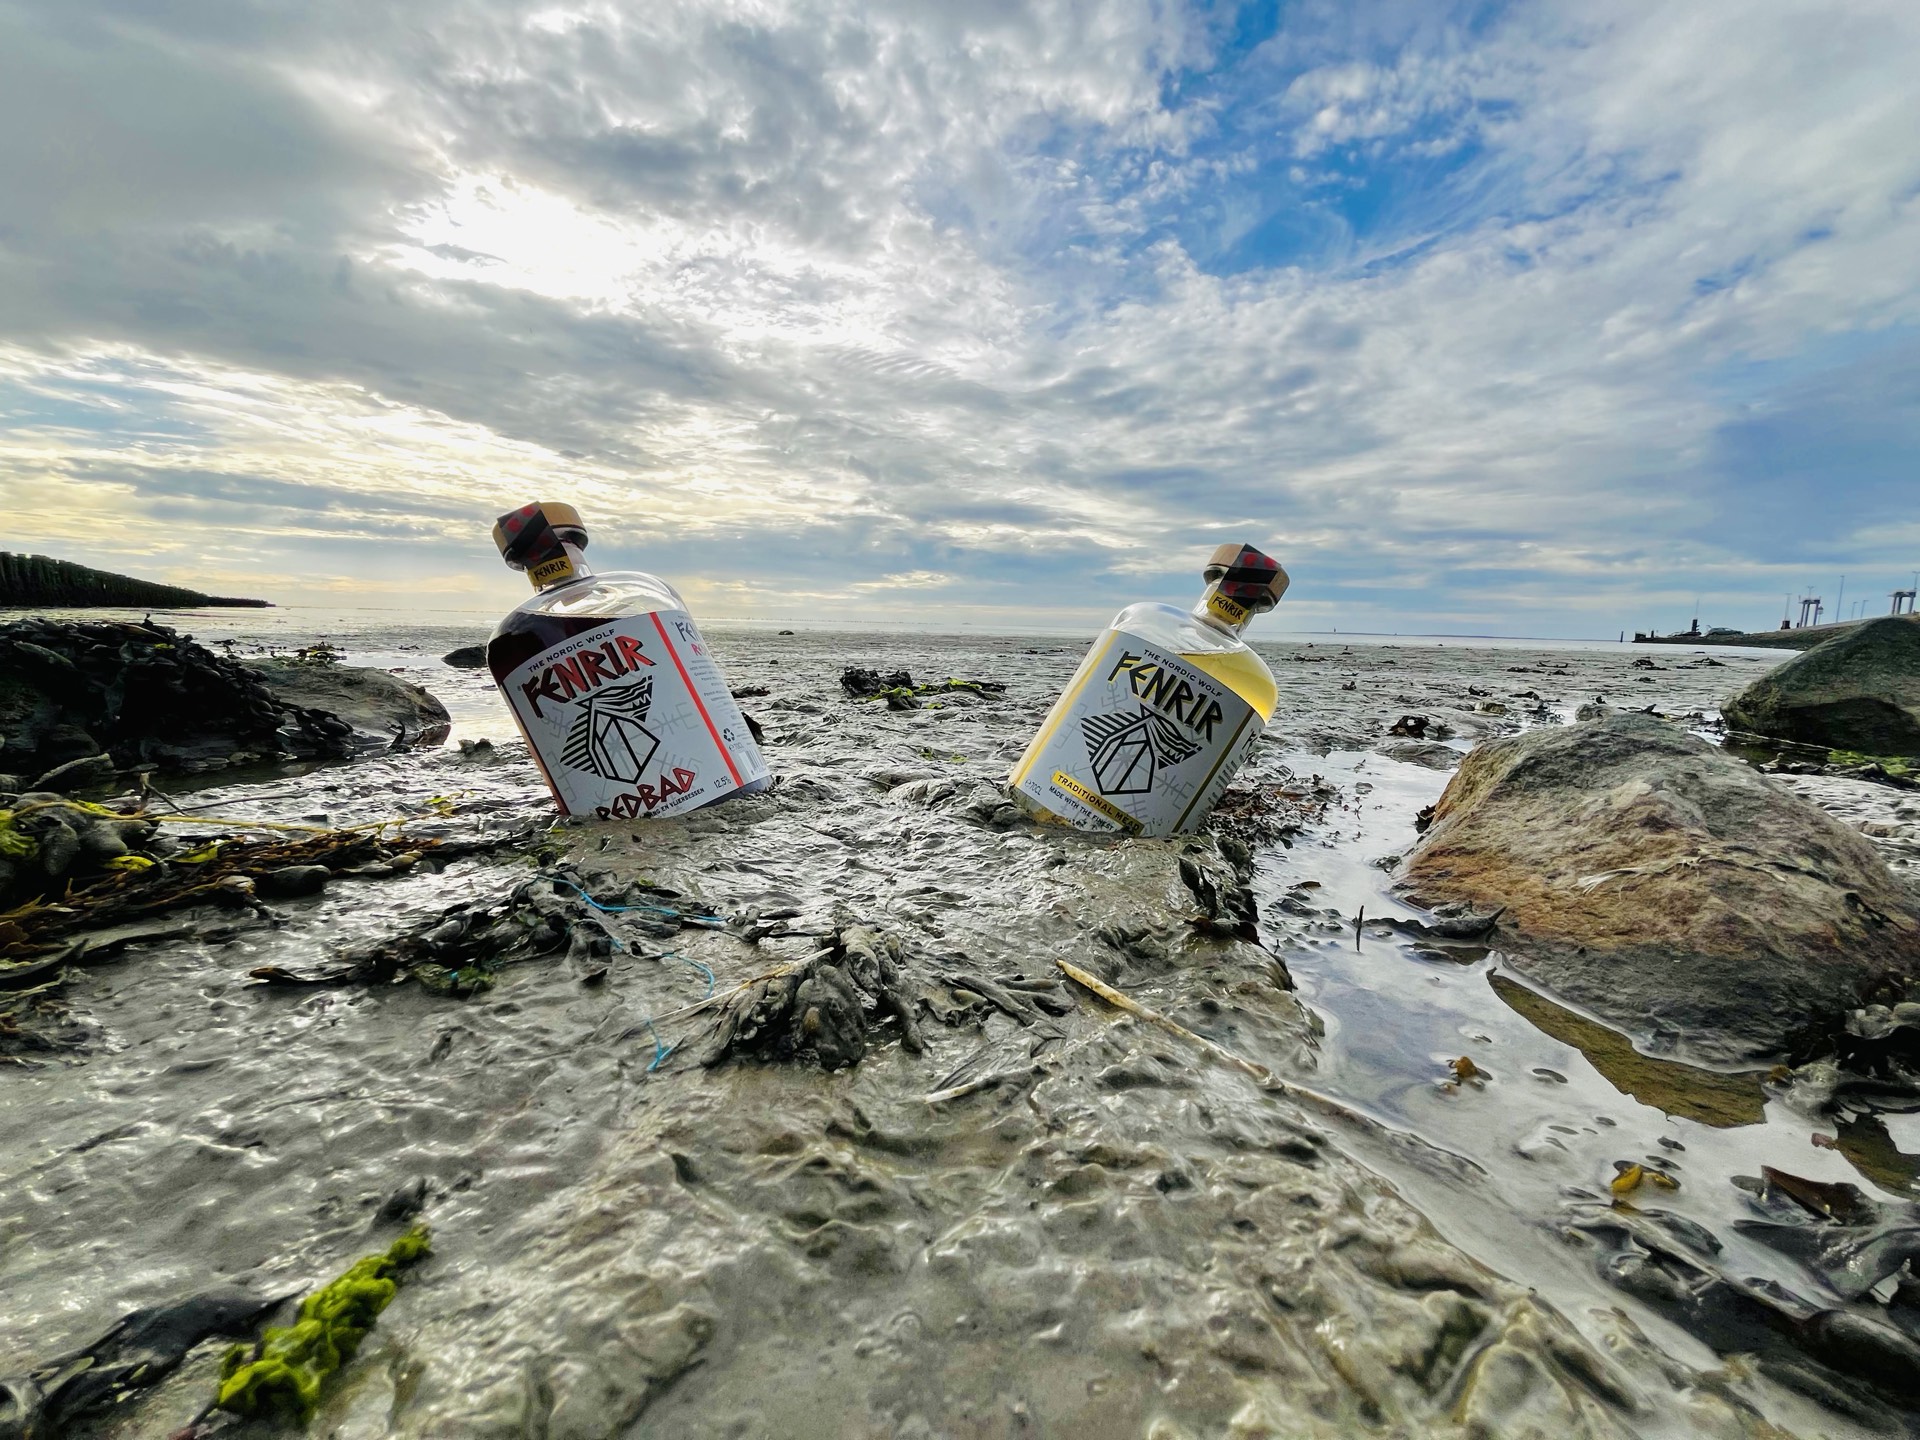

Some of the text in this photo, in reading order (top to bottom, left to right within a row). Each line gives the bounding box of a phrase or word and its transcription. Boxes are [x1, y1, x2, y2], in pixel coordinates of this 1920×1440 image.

[533, 560, 568, 581] FENRIR
[1212, 595, 1244, 620] FENRIR
[527, 628, 616, 673] THE NORDIC WOLF
[521, 635, 657, 719] FENRIR
[1144, 649, 1223, 698] THE NORDIC WOLF
[1107, 651, 1224, 745] FENRIR
[595, 767, 696, 820] REDBAD
[1049, 786, 1064, 800] MADE
[1064, 796, 1079, 810] WITH
[1080, 806, 1092, 817] THE
[1091, 814, 1115, 831] FINEST
[1057, 774, 1113, 816] TRADITIONAL
